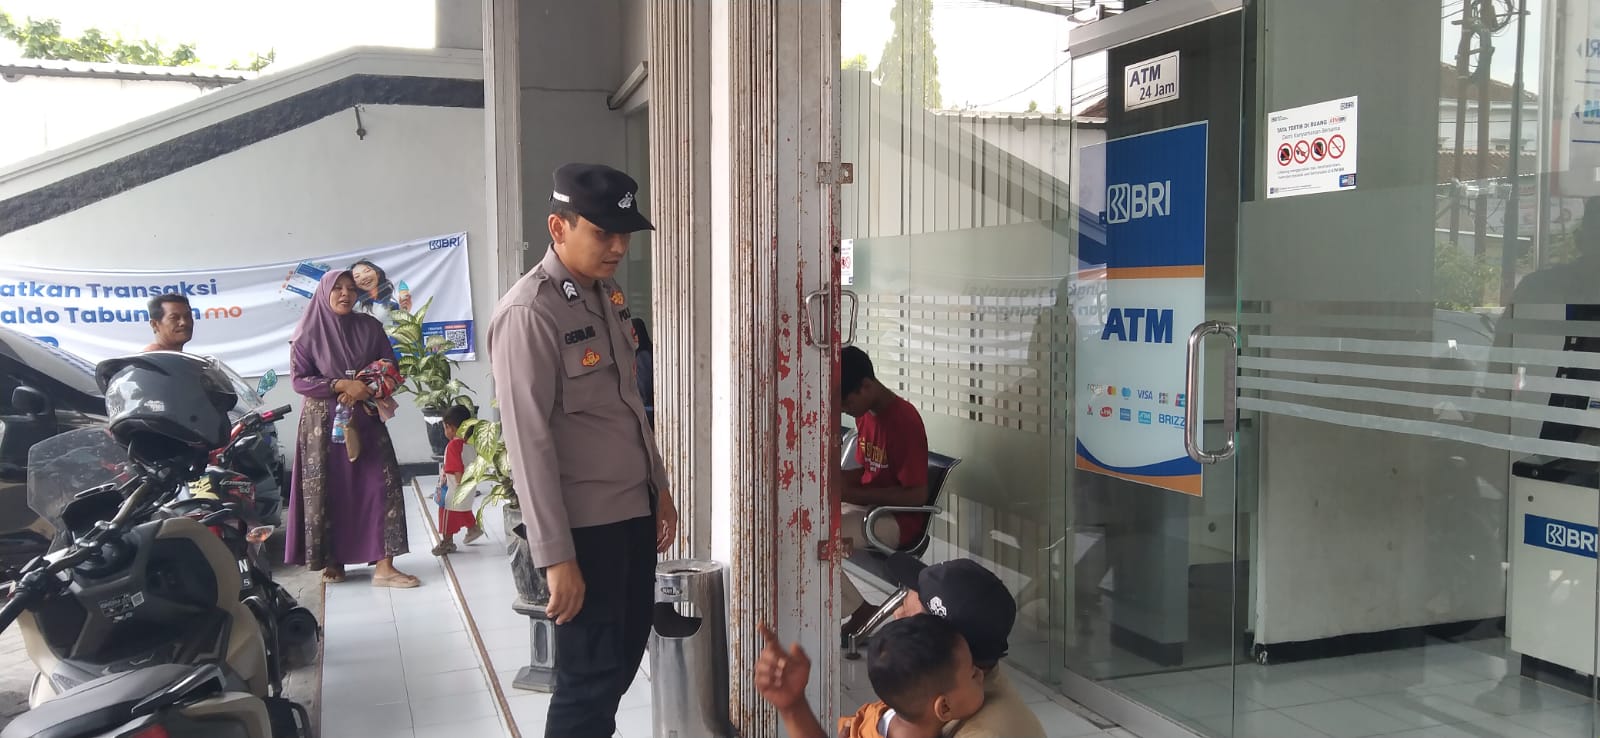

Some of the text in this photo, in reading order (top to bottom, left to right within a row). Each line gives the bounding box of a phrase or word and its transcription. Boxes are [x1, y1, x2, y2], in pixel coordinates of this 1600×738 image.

[1130, 64, 1161, 88] ATM
[1139, 82, 1175, 101] 24 Jam
[1131, 180, 1171, 219] BRI
[440, 236, 461, 249] BRI
[0, 278, 218, 299] atkan Transaksi
[0, 307, 60, 324] aldo
[205, 305, 242, 320] mo
[1101, 308, 1174, 344] ATM
[1138, 389, 1153, 400] VISA
[1566, 528, 1598, 552] BRI
